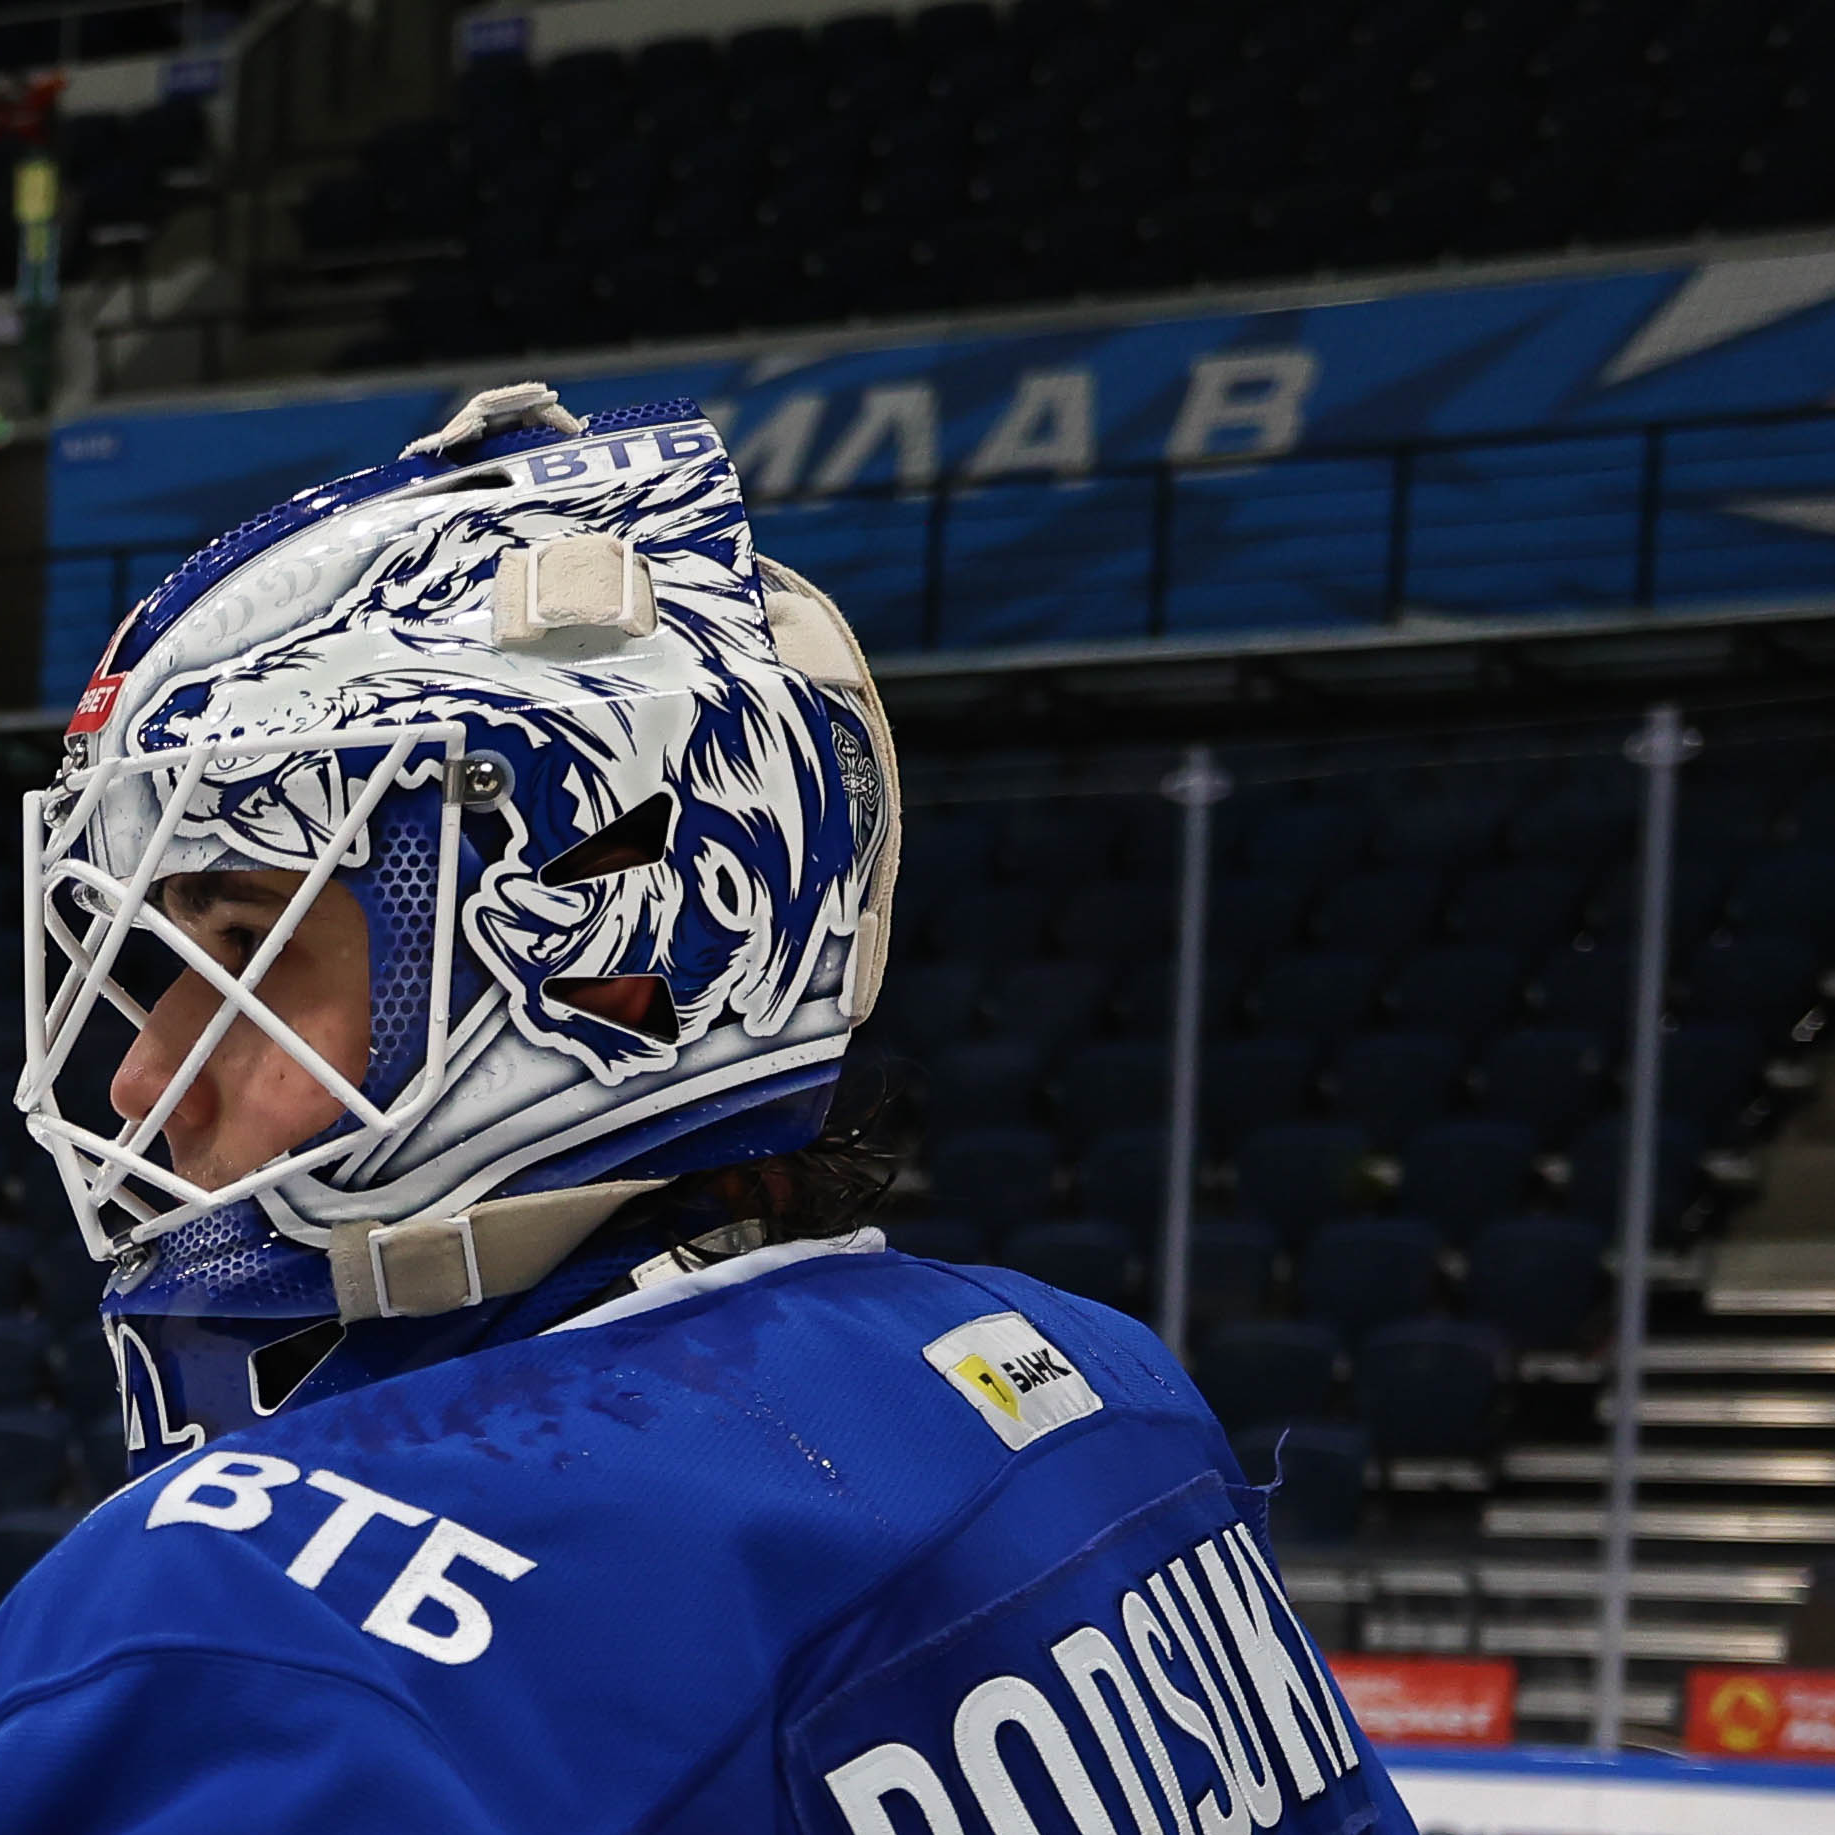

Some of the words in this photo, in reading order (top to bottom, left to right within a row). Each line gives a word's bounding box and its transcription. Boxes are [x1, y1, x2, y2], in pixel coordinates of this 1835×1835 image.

[526, 421, 718, 486] ВТБ
[1001, 1348, 1073, 1394] БАНК
[145, 1452, 538, 1666] ВТБ
